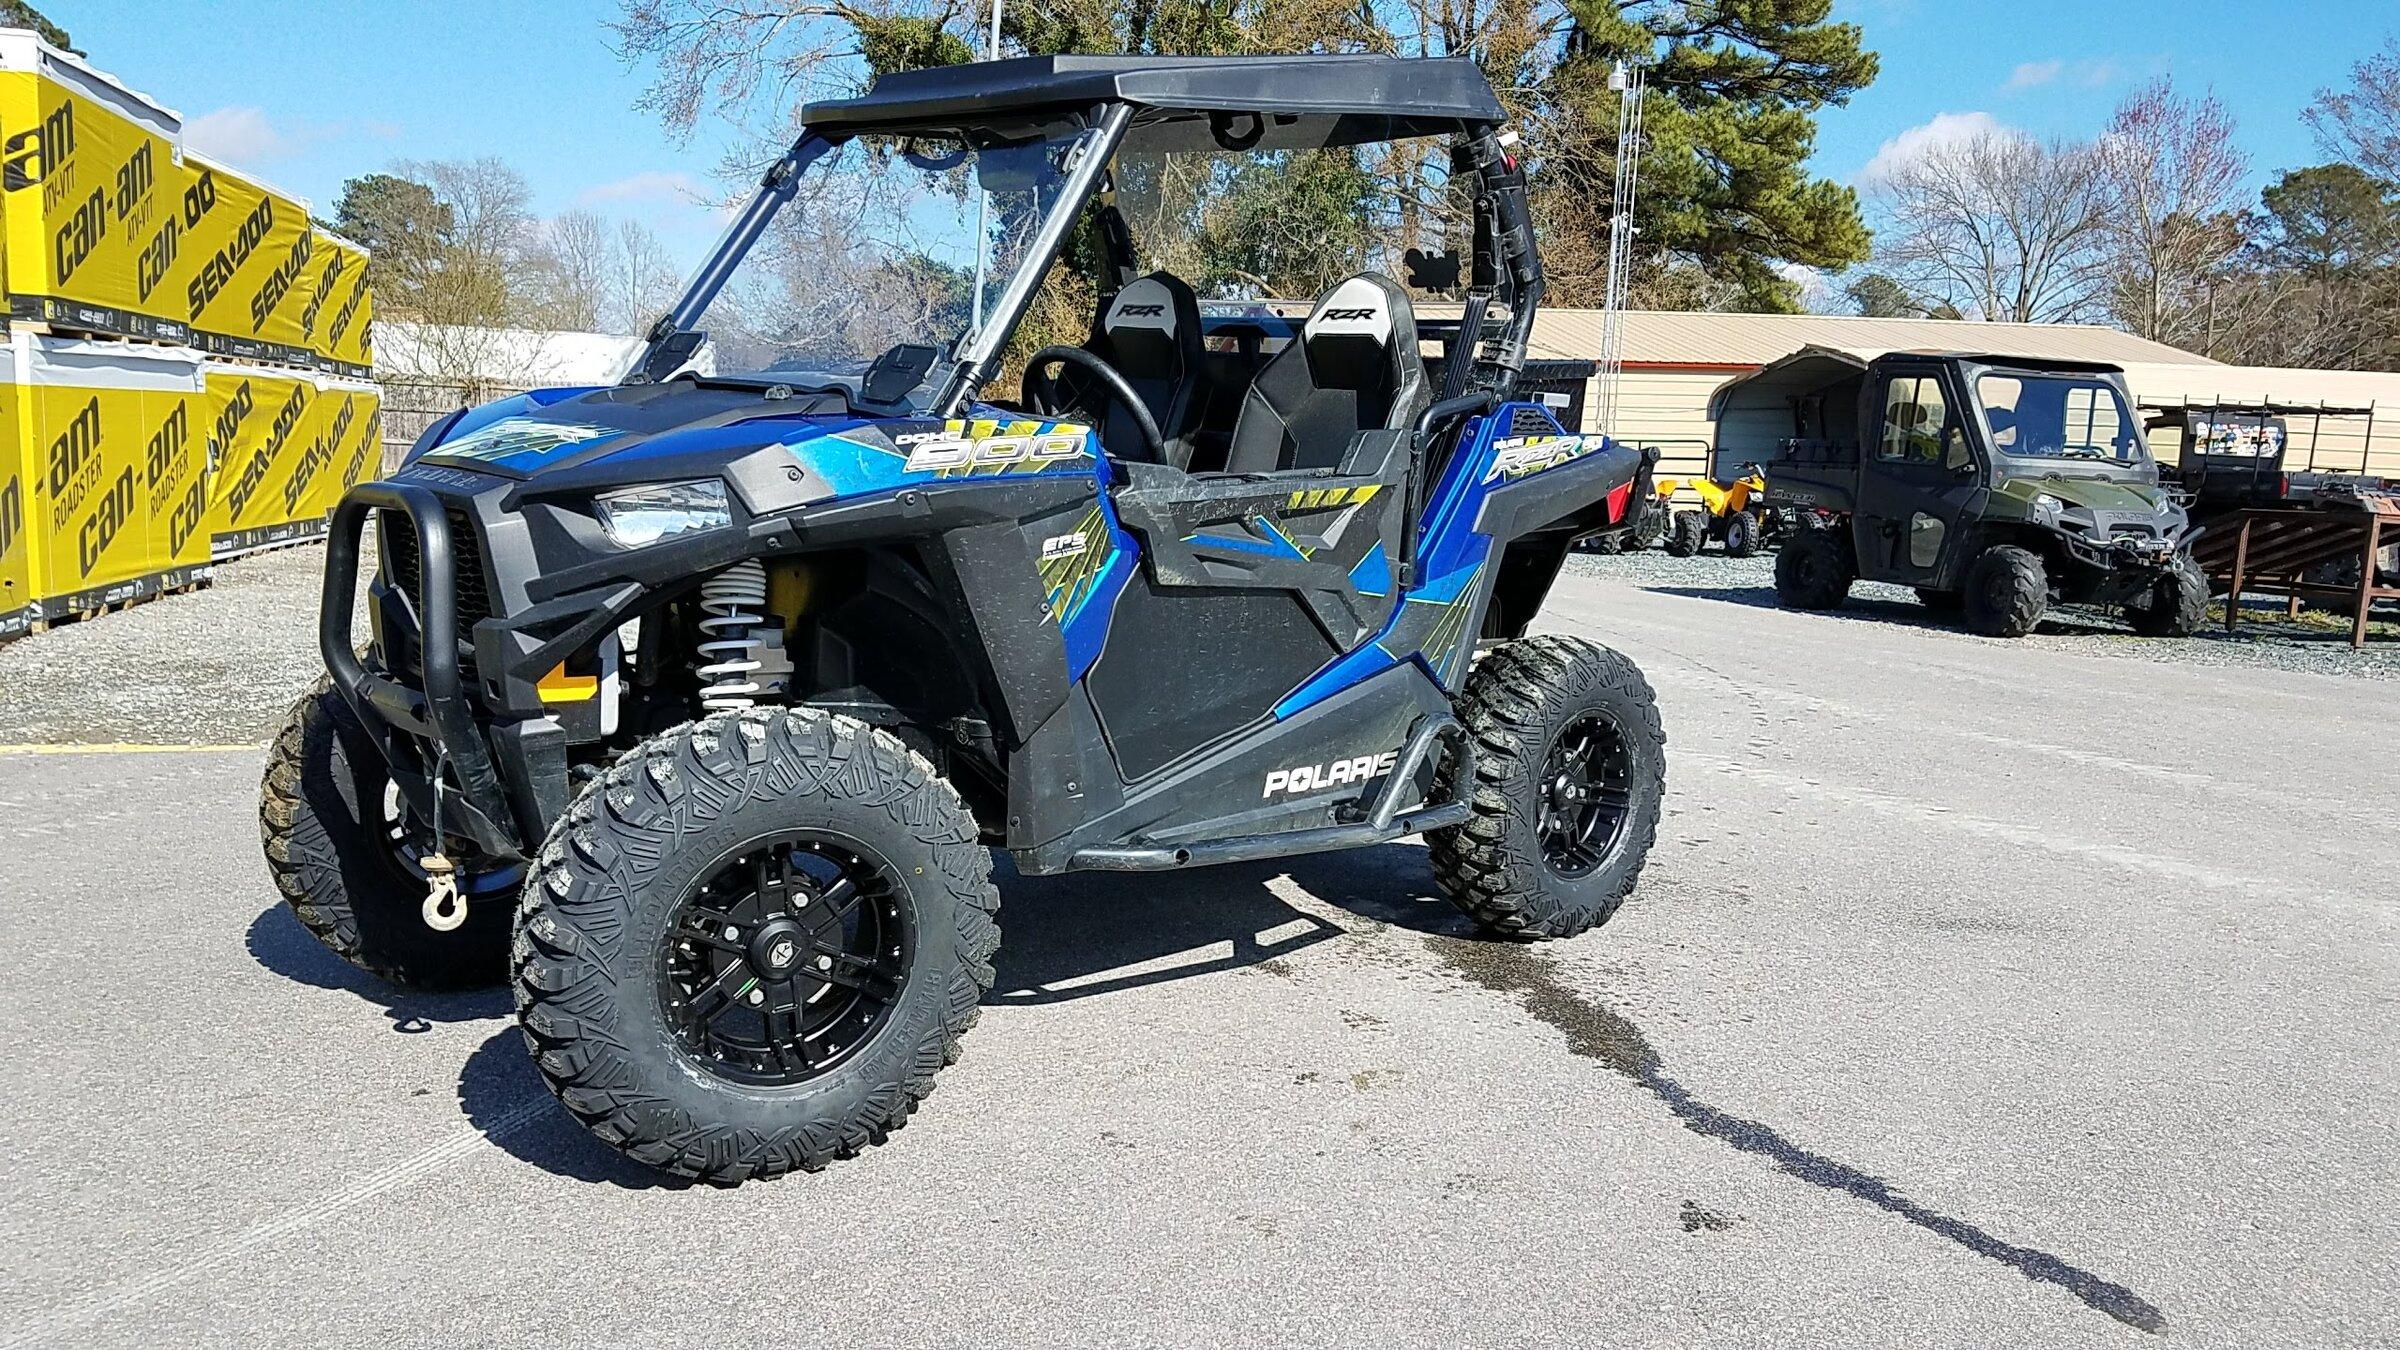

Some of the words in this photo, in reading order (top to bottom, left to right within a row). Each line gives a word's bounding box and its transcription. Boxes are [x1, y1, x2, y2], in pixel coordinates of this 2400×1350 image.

[1116, 303, 1166, 318] RZR
[1318, 308, 1378, 323] RZR
[903, 434, 1088, 473] 900
[1481, 436, 1582, 486] RZR
[53, 451, 103, 535] ROADSTER
[150, 448, 189, 521] ROADSTER
[1043, 531, 1087, 552] EPS
[1263, 751, 1400, 798] POLARIS
